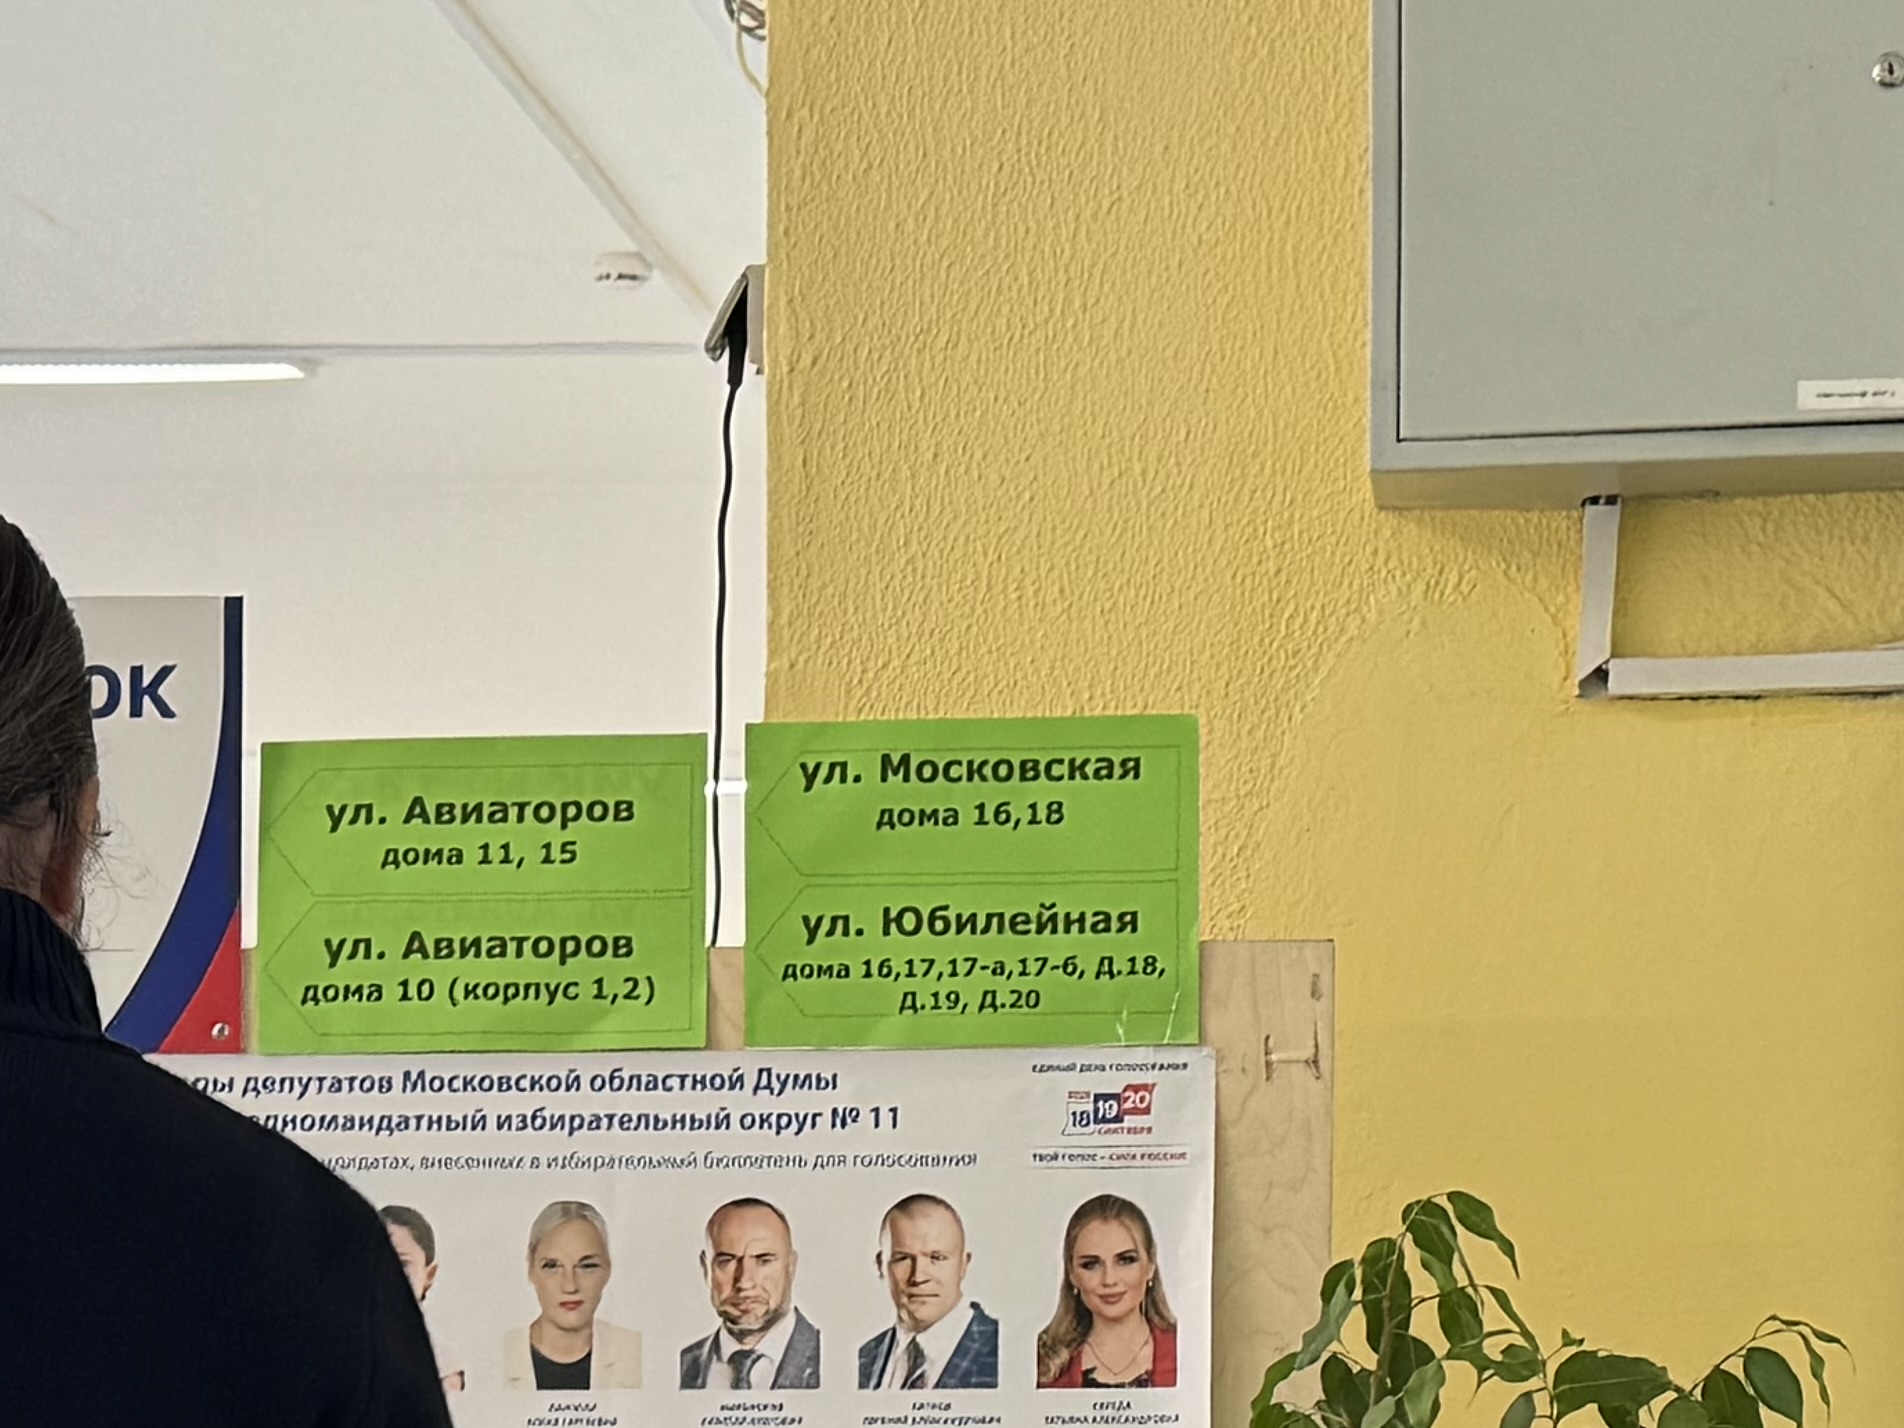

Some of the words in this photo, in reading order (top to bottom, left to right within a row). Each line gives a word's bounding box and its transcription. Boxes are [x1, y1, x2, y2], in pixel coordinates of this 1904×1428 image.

[798, 758, 863, 793] ул.
[878, 752, 1142, 784] Московская
[324, 798, 387, 833] ул.
[402, 795, 636, 830] Авиаторов
[876, 804, 959, 831] дома
[972, 800, 1064, 831] 16,18
[380, 844, 464, 870] дома
[476, 841, 526, 869] 11,
[540, 839, 578, 864] 15
[800, 912, 865, 946] ул.
[880, 902, 1140, 938] Юбилейная
[323, 933, 386, 970] ул.
[401, 929, 634, 966] Авиаторов
[782, 961, 850, 982] дома
[1095, 954, 1166, 979] Д.18,
[300, 981, 384, 1007] дома
[397, 977, 435, 1001] 10
[448, 975, 580, 1006] (корпус
[591, 975, 656, 1006] 1,2)
[899, 991, 968, 1015] Д.19,
[978, 988, 1040, 1014] Д.20
[242, 1073, 392, 1099] депутатов
[402, 1068, 580, 1094] Московской
[590, 1066, 744, 1092] областной
[753, 1066, 837, 1096] Думы
[497, 1106, 730, 1136] избирательный
[740, 1111, 822, 1135] округ
[832, 1106, 859, 1130] №
[871, 1106, 898, 1129] 11
[1071, 1110, 1090, 1128] 18
[1098, 1100, 1118, 1118] 19
[1122, 1090, 1151, 1109] 20
[814, 1153, 846, 1170] для
